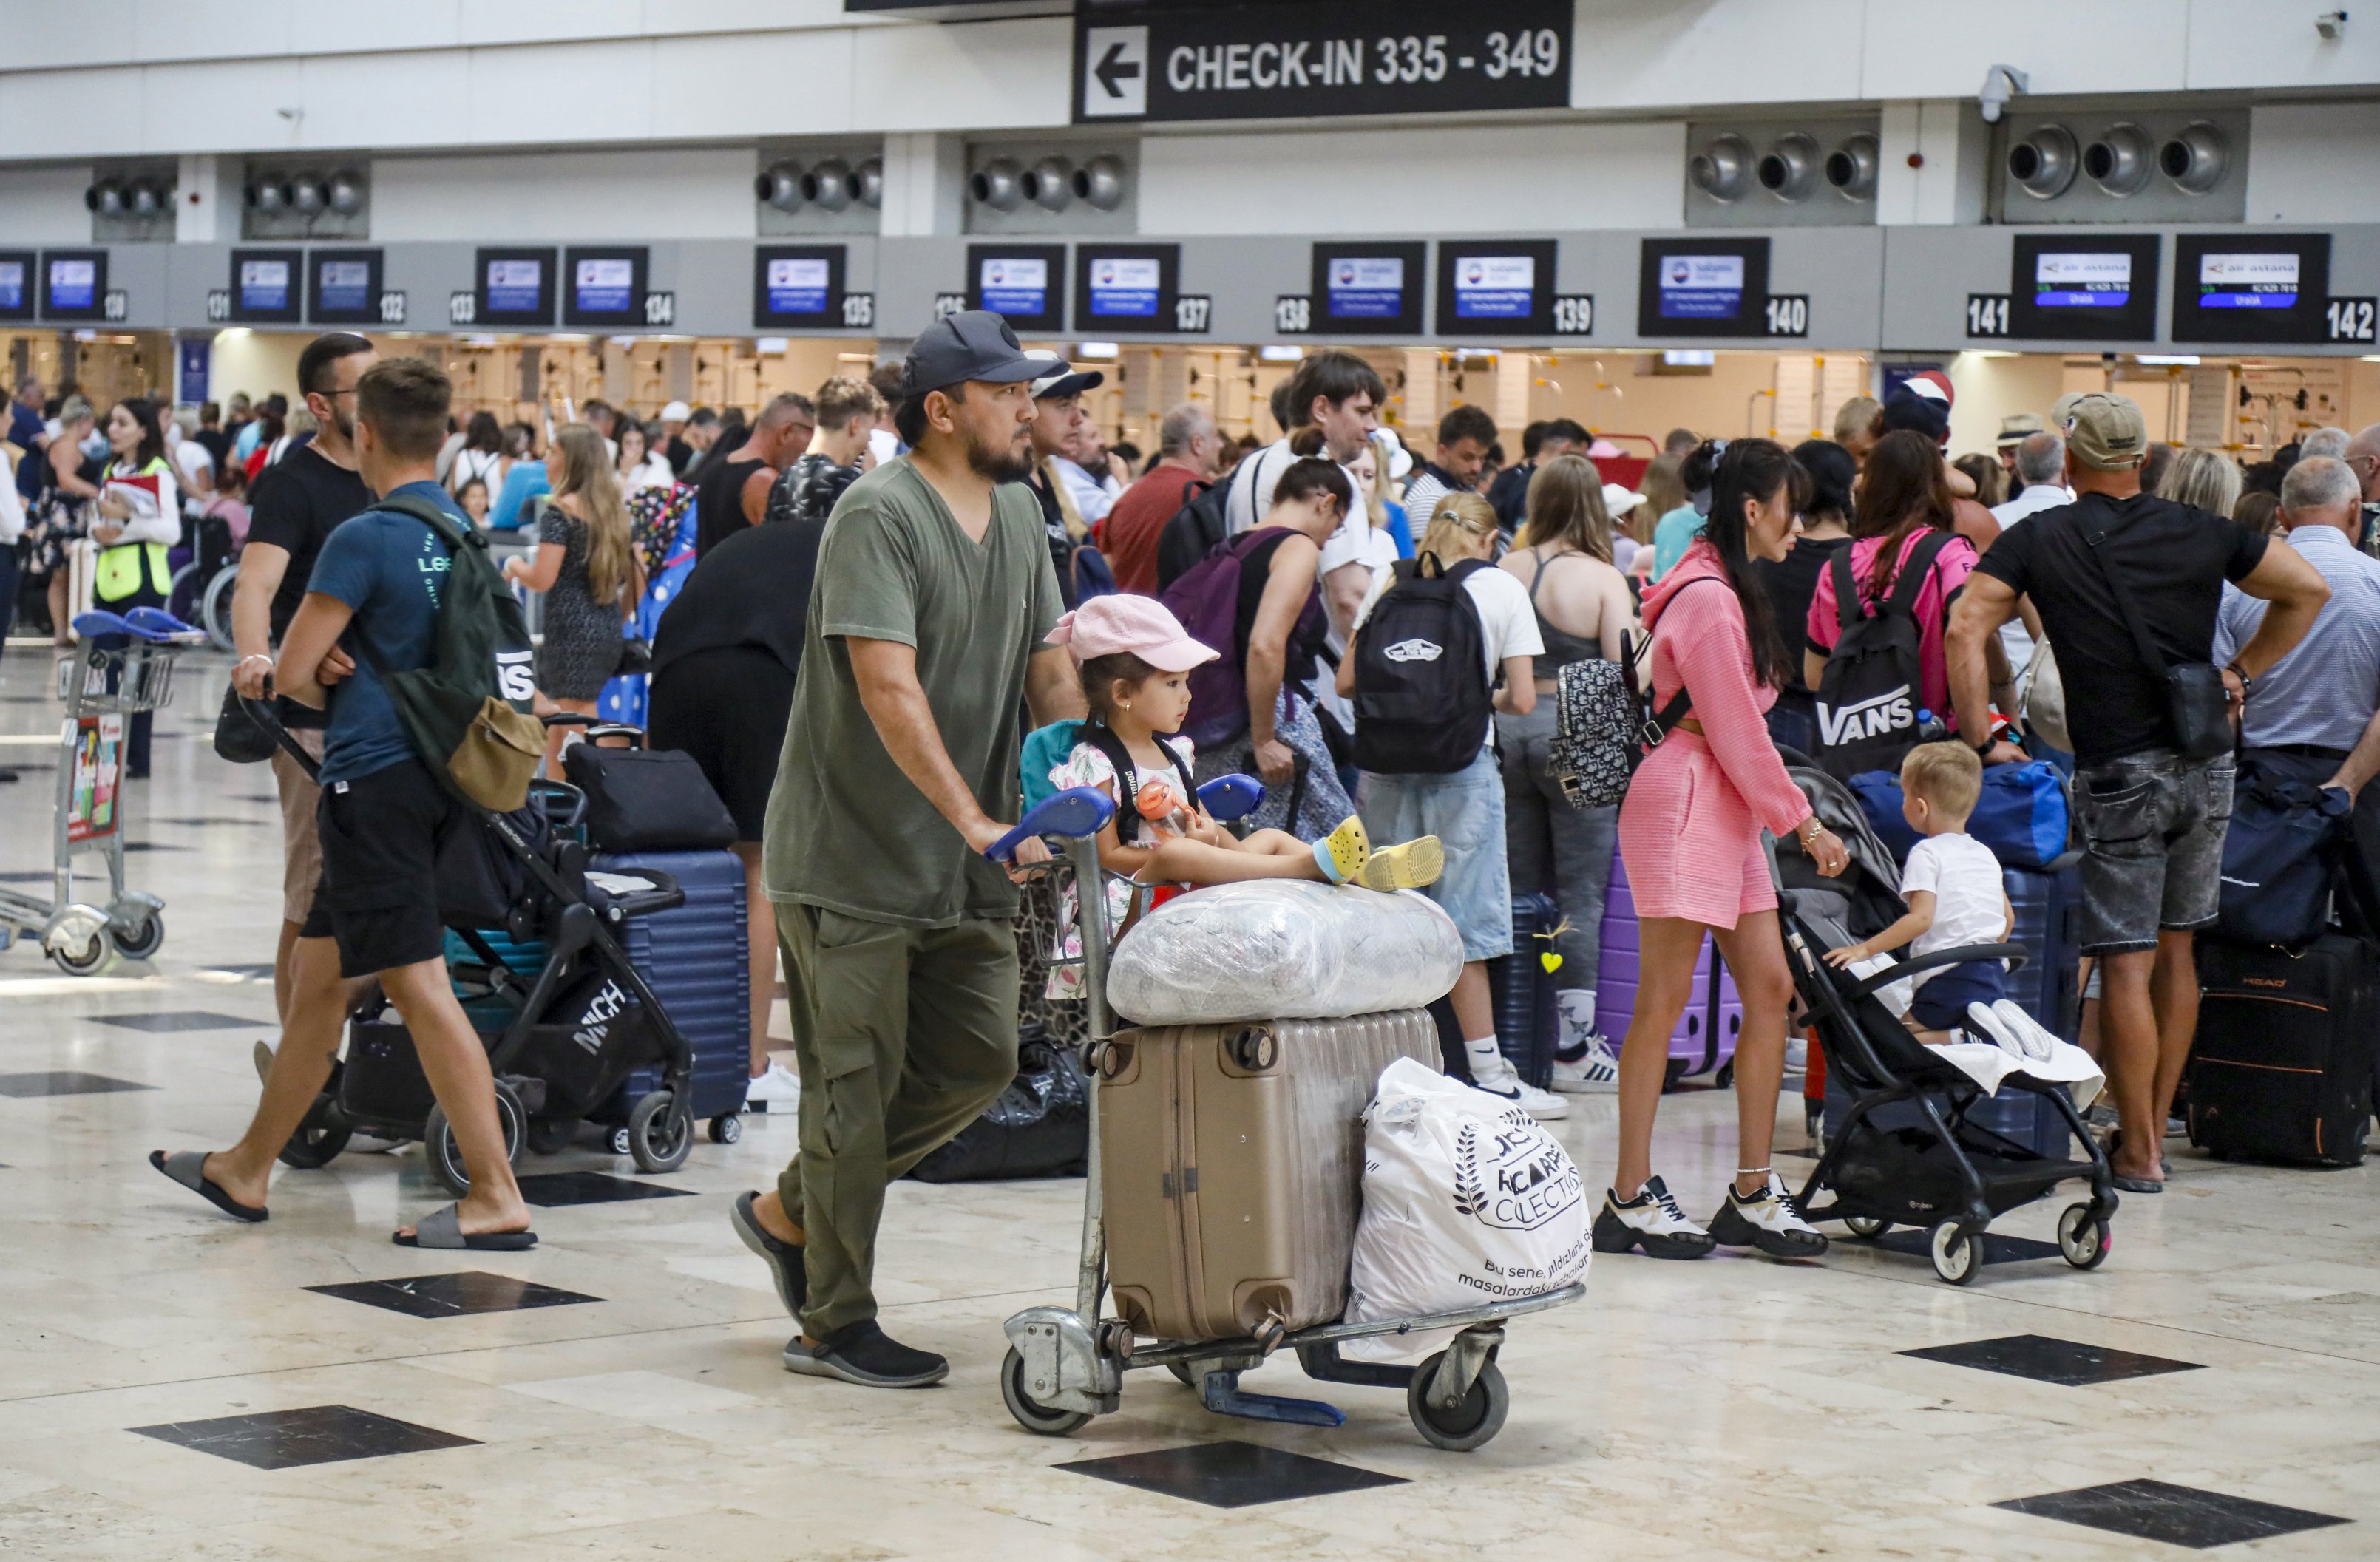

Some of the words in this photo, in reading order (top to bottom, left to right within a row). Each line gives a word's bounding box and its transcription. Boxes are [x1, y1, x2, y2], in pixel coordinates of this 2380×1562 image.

[1167, 39, 1363, 92] CHECK-IN
[1375, 36, 1447, 84] 335
[1485, 29, 1559, 80] 349
[645, 293, 672, 325] 134
[843, 295, 872, 327] 135
[1176, 298, 1210, 332] 137
[1277, 298, 1310, 331] 138
[1553, 298, 1592, 333] 139
[1766, 298, 1806, 334] 140
[1968, 297, 2010, 334] 141
[2326, 301, 2374, 339] 142
[1816, 683, 1913, 746] VANS
[2242, 977, 2287, 988] HEAD
[1485, 1257, 1505, 1276] Bu
